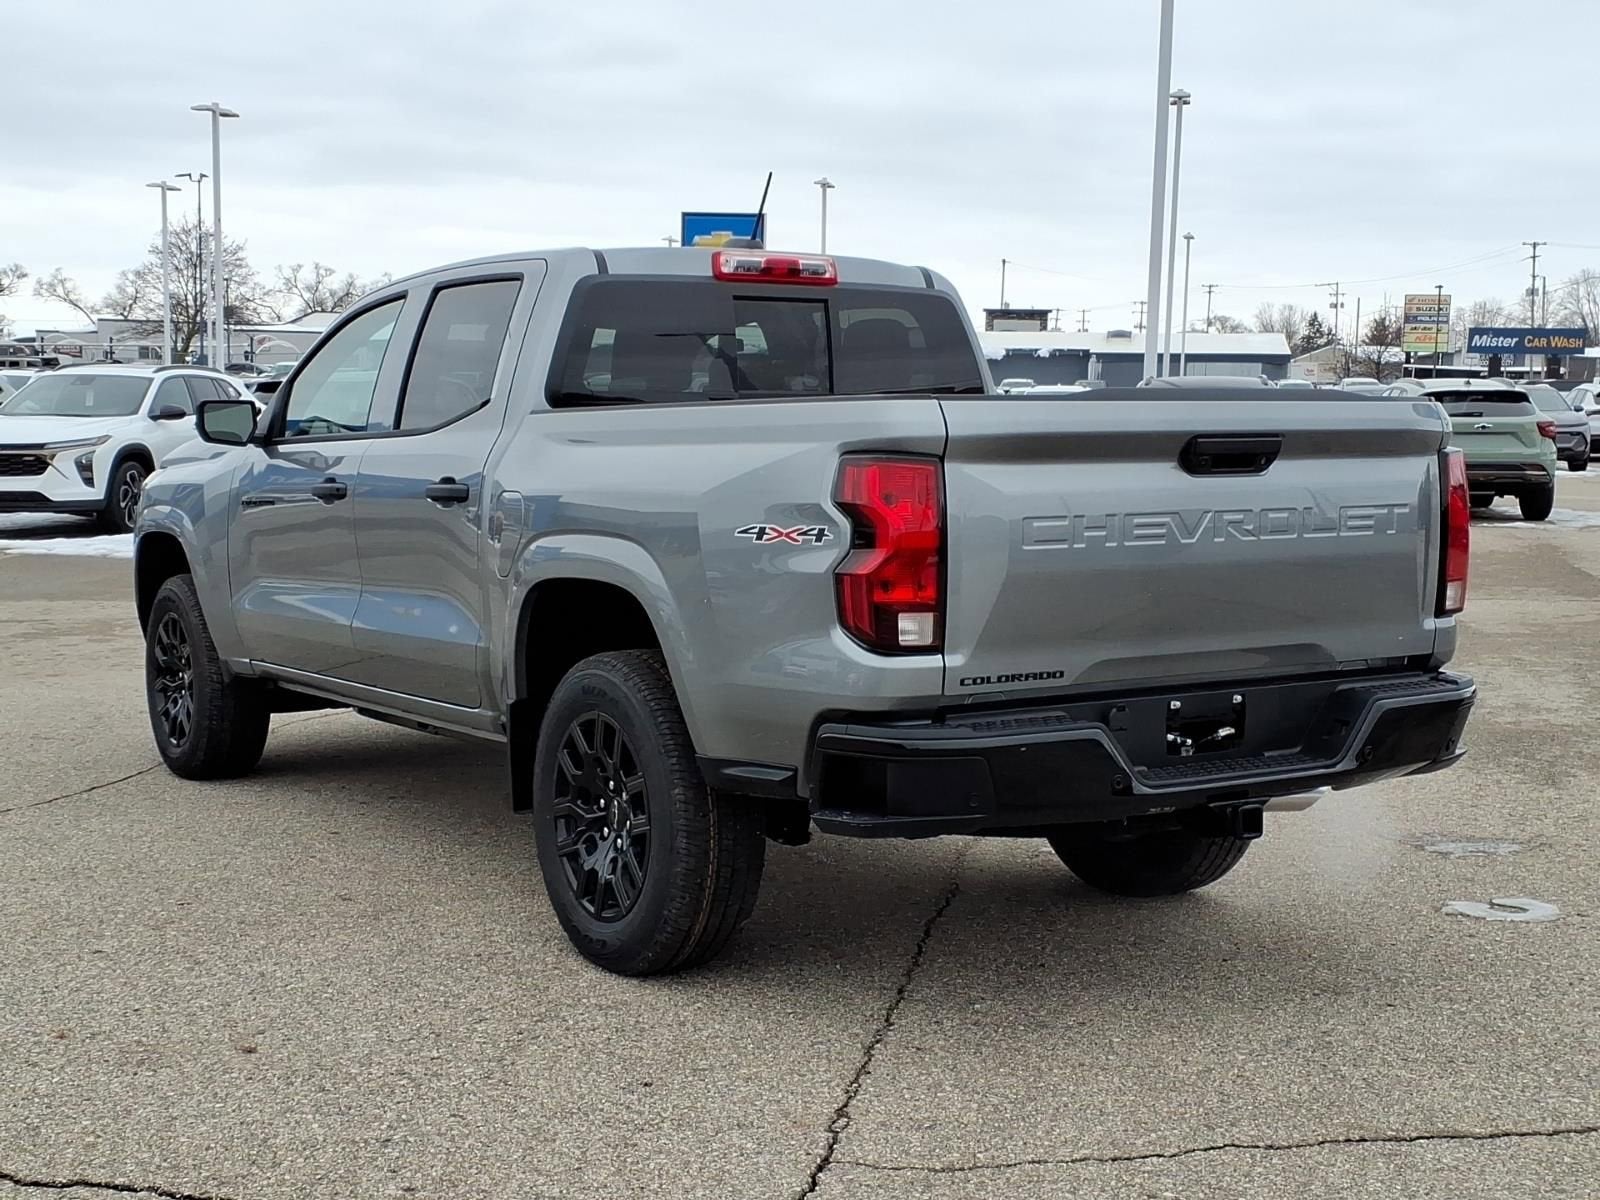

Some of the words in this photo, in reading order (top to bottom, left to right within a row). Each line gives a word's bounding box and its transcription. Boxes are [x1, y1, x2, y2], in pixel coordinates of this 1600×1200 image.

[1471, 333, 1519, 347] Mister
[1524, 335, 1547, 348] CAR
[1549, 335, 1583, 348] WASH
[1021, 503, 1410, 550] CHEVROLET
[960, 670, 1065, 687] COLORADO
